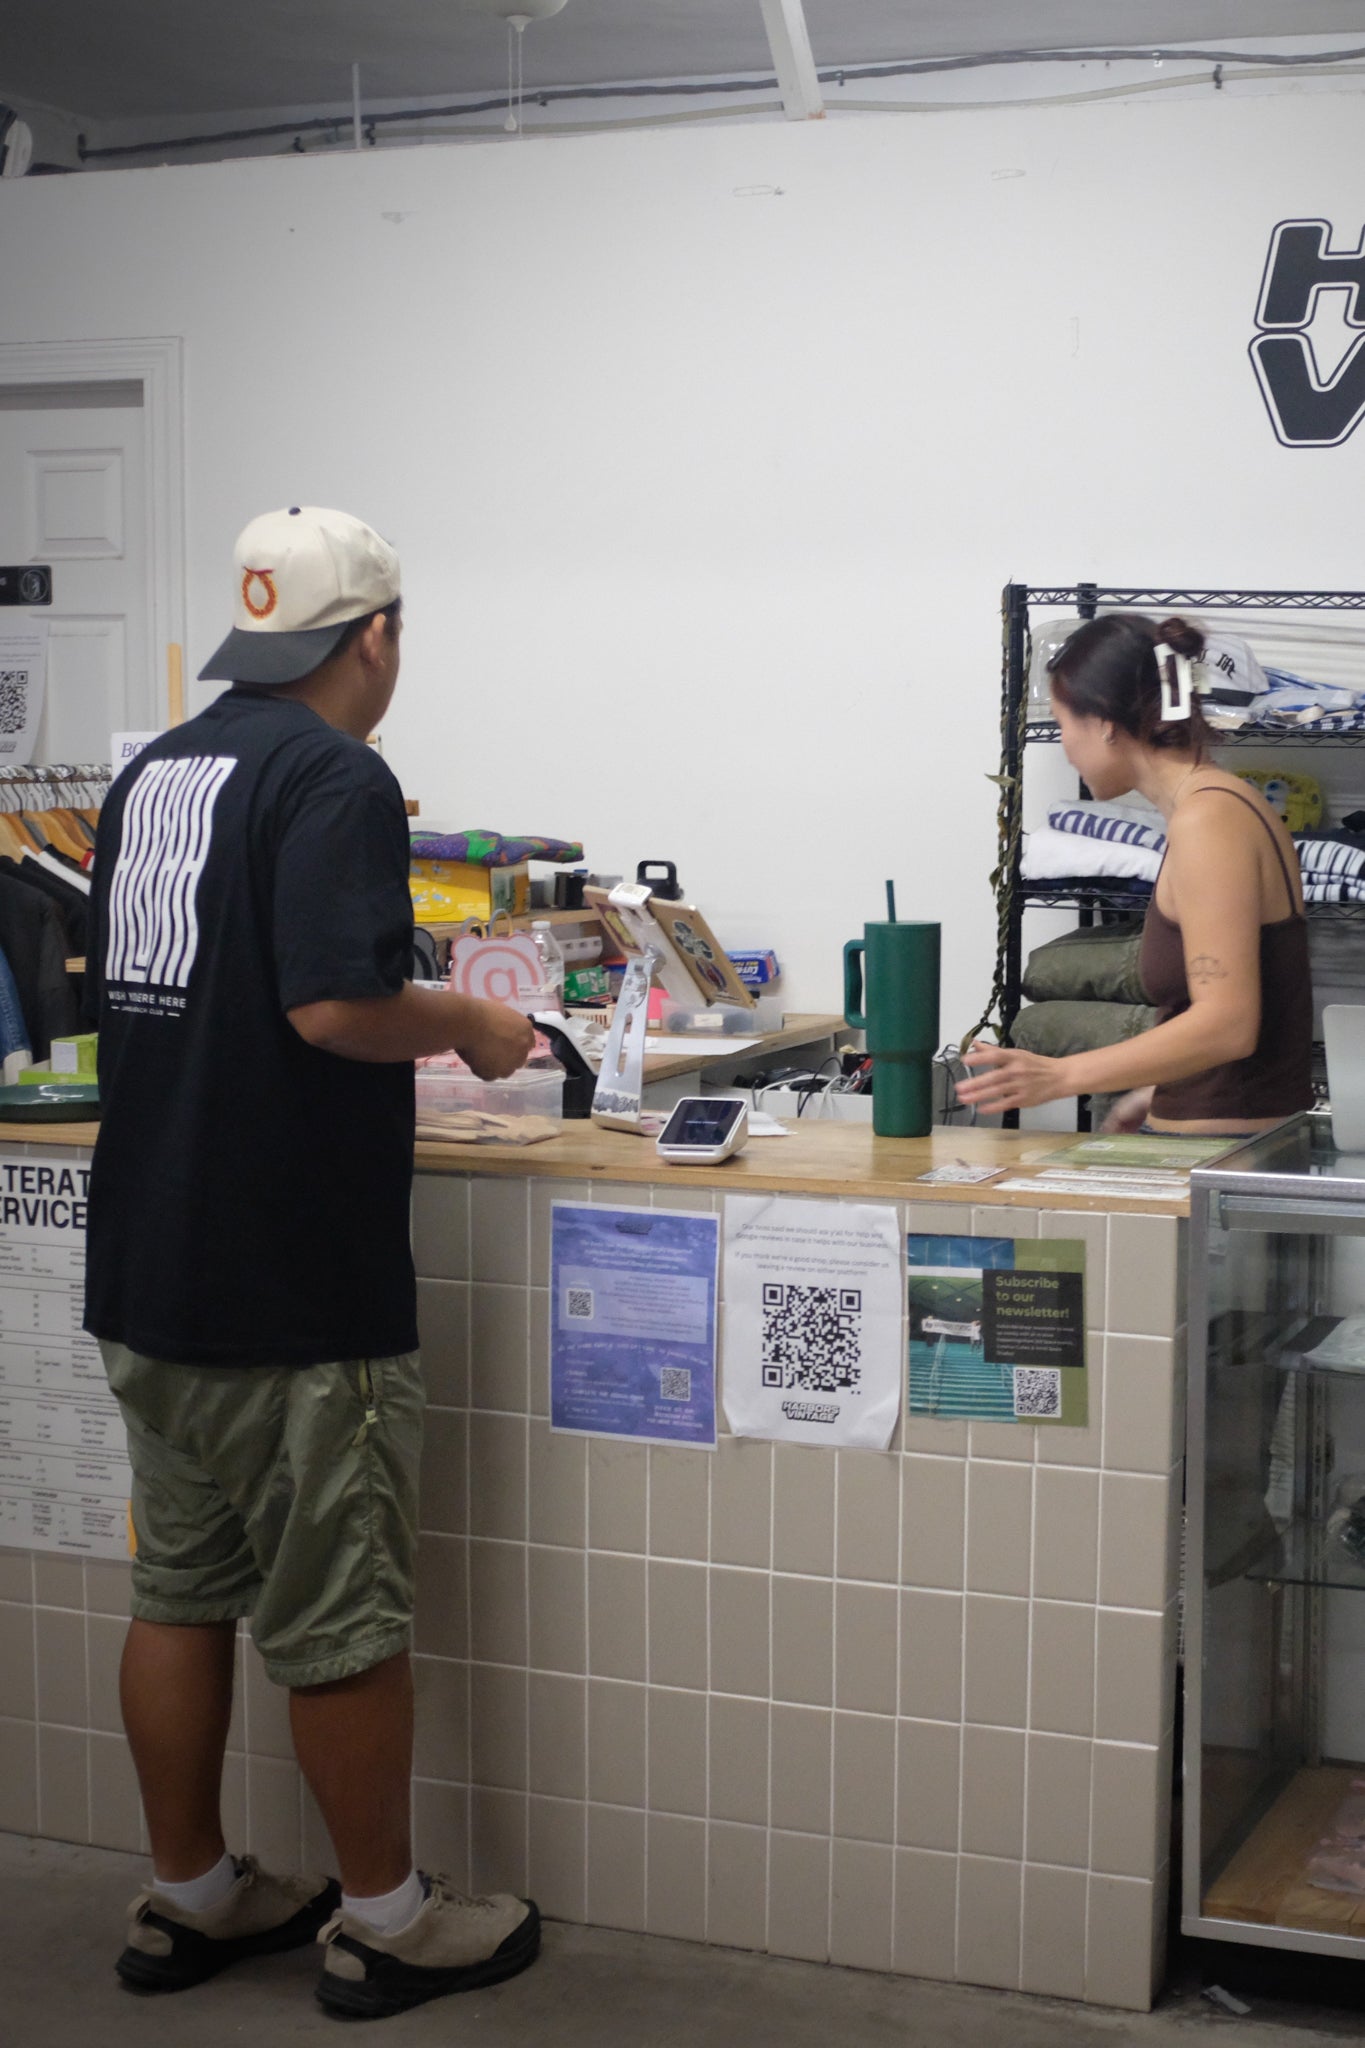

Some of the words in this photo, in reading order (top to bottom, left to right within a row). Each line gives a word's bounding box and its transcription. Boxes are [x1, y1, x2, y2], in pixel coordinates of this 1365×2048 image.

[121, 742, 151, 758] BO
[158, 996, 187, 1009] HERE
[0, 1164, 91, 1198] TERAT
[0, 1196, 88, 1230] RVICE
[996, 1276, 1059, 1288] Subscribe
[996, 1292, 1010, 1300] to
[1012, 1294, 1035, 1302] our
[996, 1306, 1070, 1318] newsletter!
[782, 1401, 840, 1414] HARBORS
[786, 1409, 836, 1423] VINTAGE
